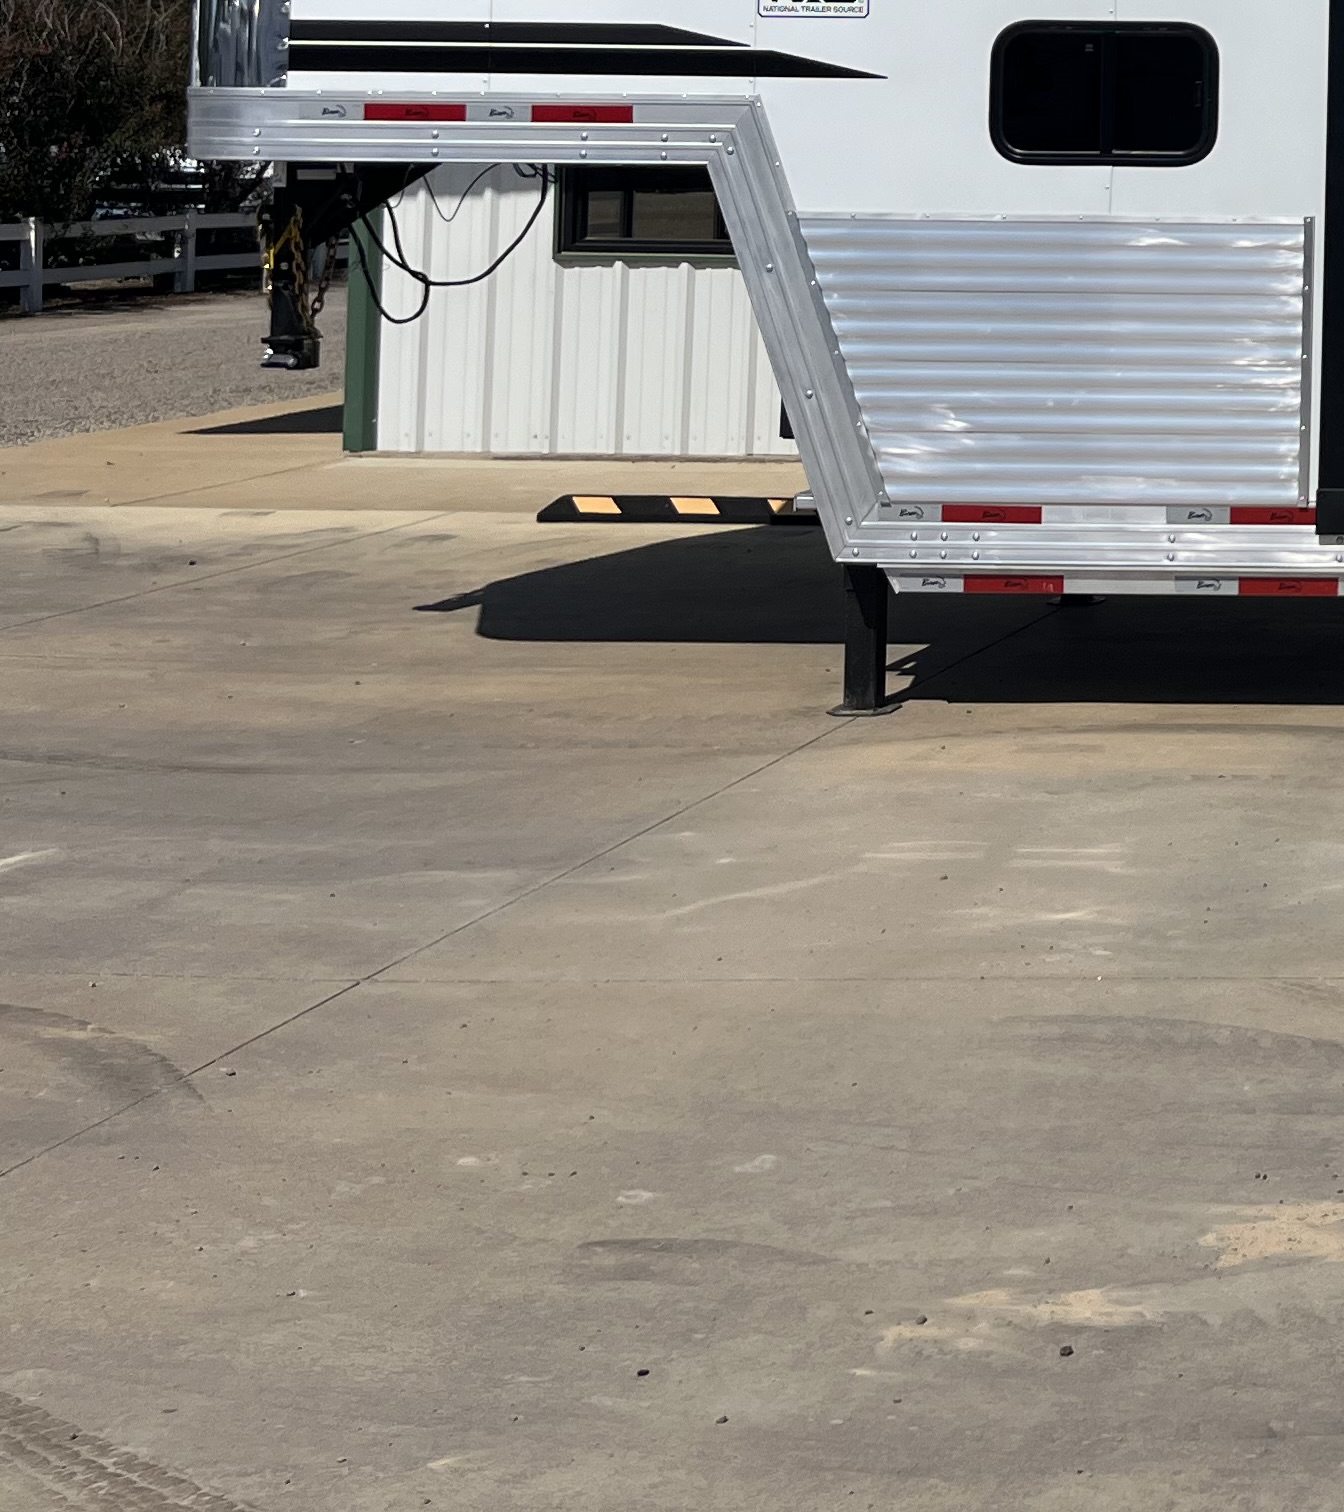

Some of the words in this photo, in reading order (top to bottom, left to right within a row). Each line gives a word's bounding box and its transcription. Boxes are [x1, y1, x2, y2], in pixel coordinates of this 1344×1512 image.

[762, 5, 799, 13] NATIONAL
[801, 5, 832, 13] TRAILER
[833, 6, 864, 14] SOURCE
